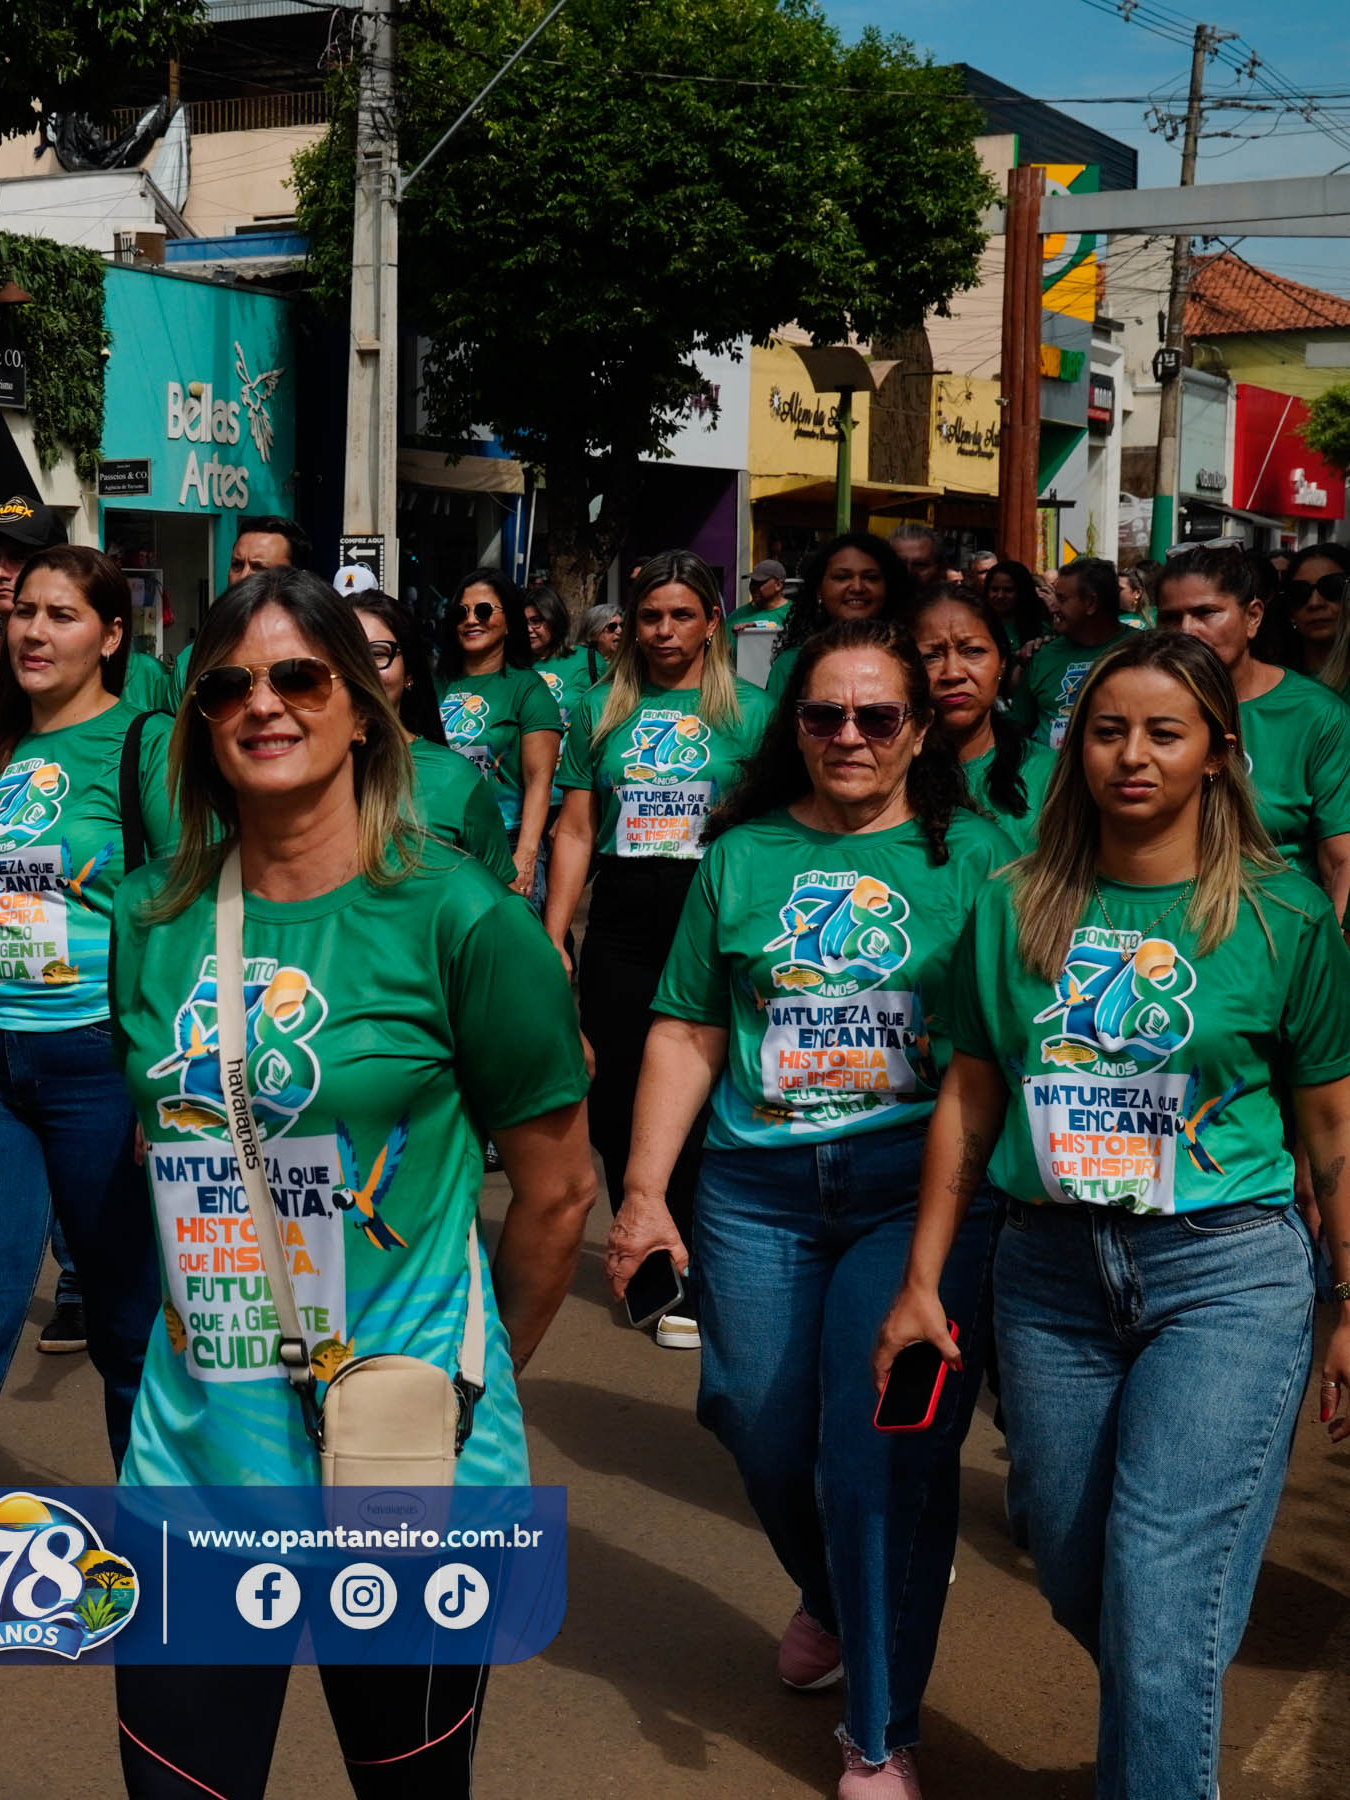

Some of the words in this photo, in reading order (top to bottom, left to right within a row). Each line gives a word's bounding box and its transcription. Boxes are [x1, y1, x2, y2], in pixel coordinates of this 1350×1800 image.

[5, 349, 23, 368] CO.
[168, 382, 240, 444] Bellas
[179, 450, 249, 509] Artes
[643, 711, 681, 720] BONITO
[638, 716, 711, 772] 78
[652, 776, 679, 785] ANOS
[622, 791, 684, 803] NATUREZA
[688, 794, 705, 804] QUE
[627, 832, 642, 841] QUE
[28, 863, 54, 875] QUE
[796, 873, 856, 887] BONITO
[790, 876, 911, 973] 78
[1074, 929, 1138, 948] BONITO
[0, 941, 56, 958] GENTE
[818, 979, 858, 996] ANOS
[1063, 938, 1197, 1053] 78
[771, 1005, 870, 1026] NATUREZA
[877, 1011, 905, 1028] QUE
[1091, 1060, 1138, 1076] ANOS
[778, 1075, 802, 1090] QUE
[1034, 1085, 1153, 1109] NATUREZA
[1158, 1096, 1178, 1112] QUE
[227, 1058, 260, 1170] havaianas
[155, 1156, 282, 1182] NATURZA
[288, 1166, 330, 1188] QUE
[1052, 1161, 1077, 1177] QUE
[197, 1186, 333, 1219] ENCNTA,
[179, 1253, 209, 1272] QUE
[190, 1314, 224, 1333] QUE
[231, 1313, 241, 1331] A
[245, 1306, 330, 1333] GETE
